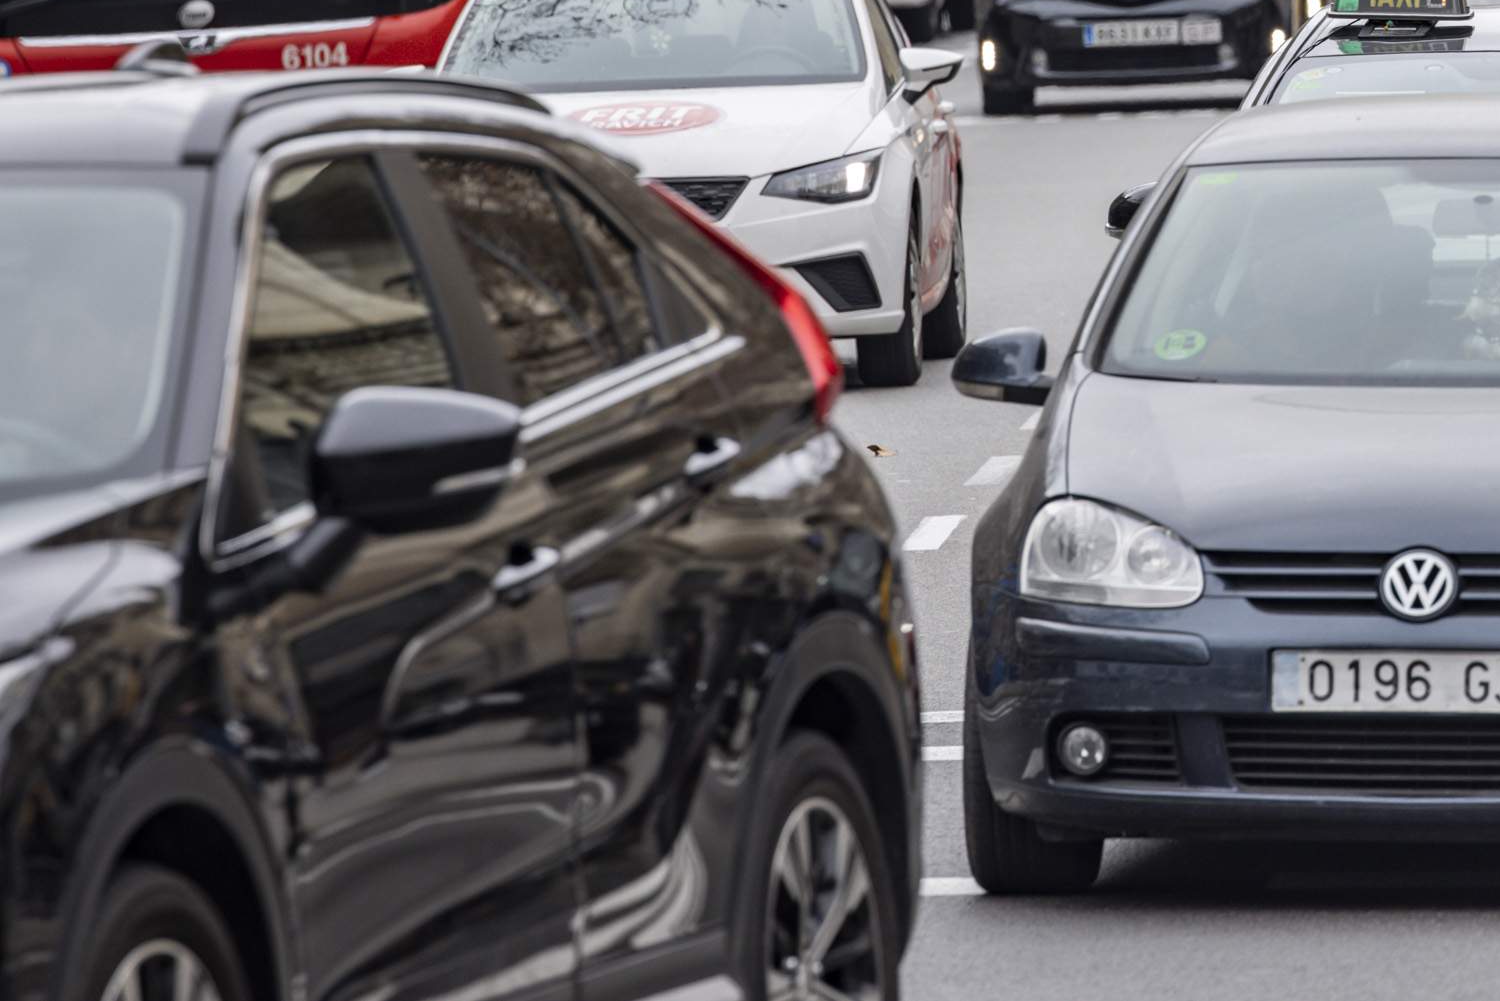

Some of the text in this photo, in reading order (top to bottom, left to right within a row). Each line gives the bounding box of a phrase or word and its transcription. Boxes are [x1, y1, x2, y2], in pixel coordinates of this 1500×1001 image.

[281, 41, 348, 71] 6104
[581, 106, 703, 122] FRIT
[1308, 659, 1431, 702] 0196
